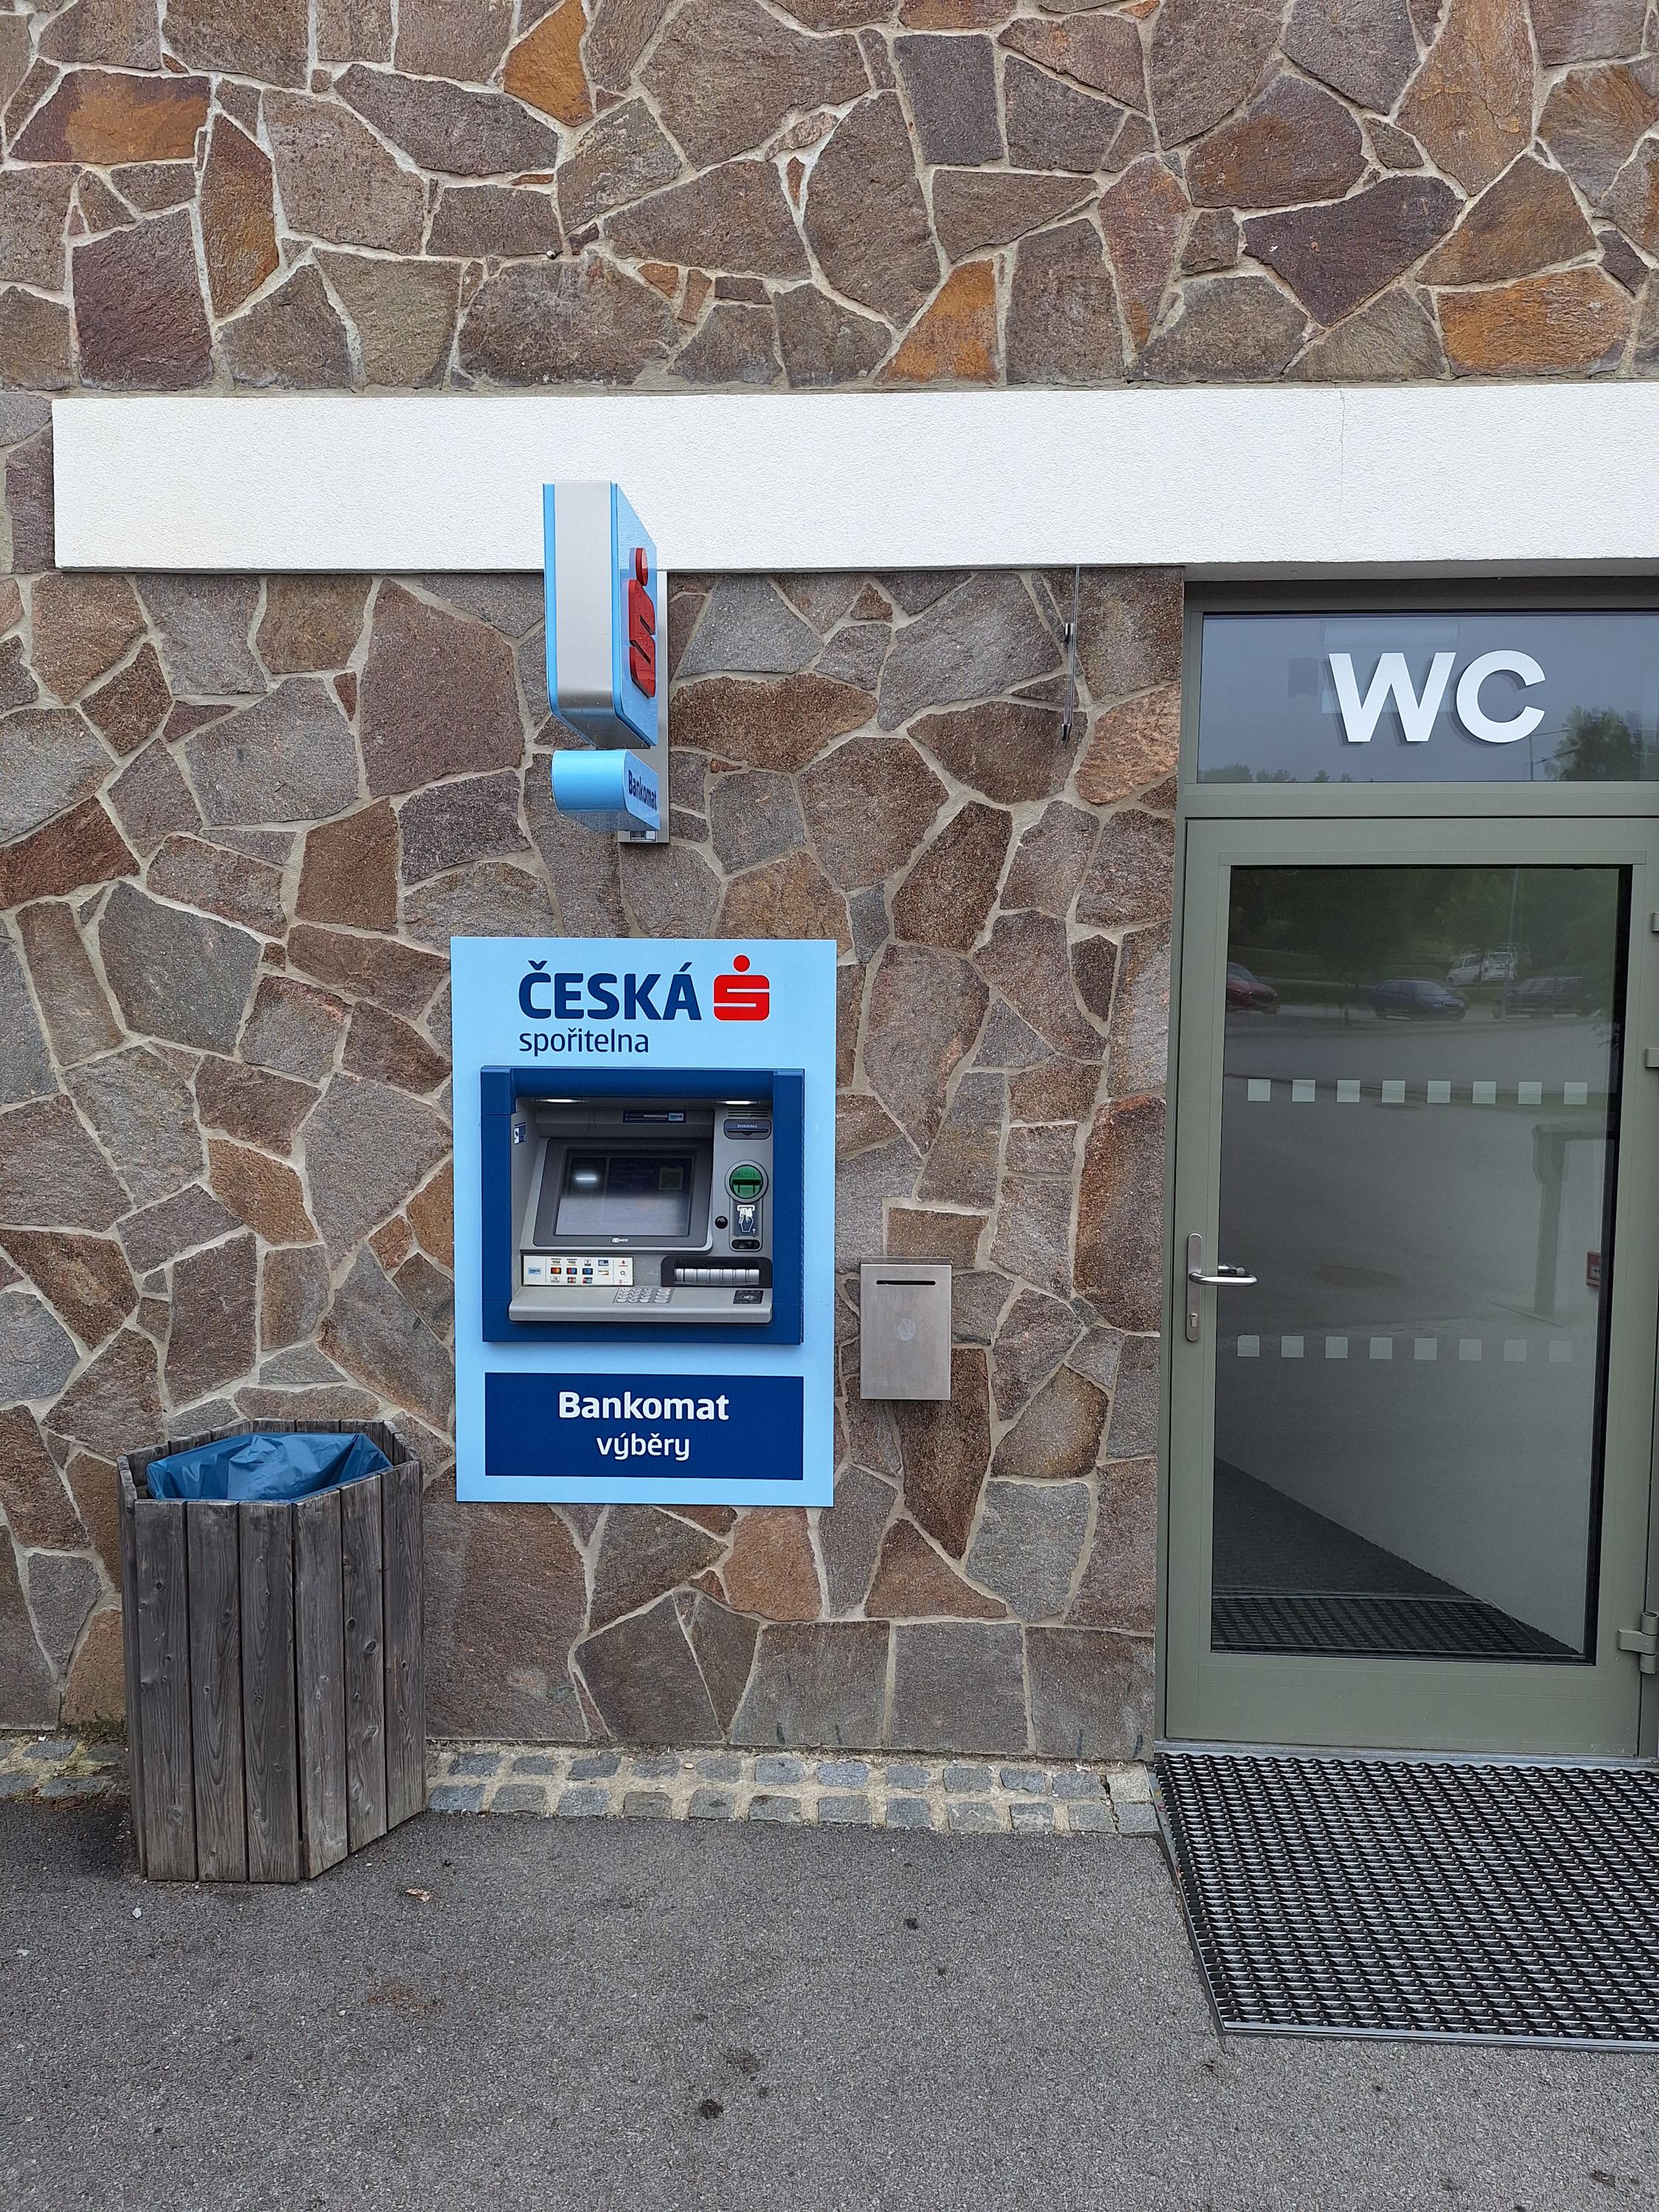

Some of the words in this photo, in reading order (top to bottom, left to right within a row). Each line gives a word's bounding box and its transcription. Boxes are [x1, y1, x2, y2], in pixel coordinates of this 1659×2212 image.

[1329, 650, 1545, 743] WC
[628, 769, 657, 812] Bankomat
[518, 960, 702, 1020] ČESKÁ
[518, 1028, 649, 1057] spořitelna
[558, 1391, 730, 1421] Bankomat
[596, 1433, 690, 1461] výběry
